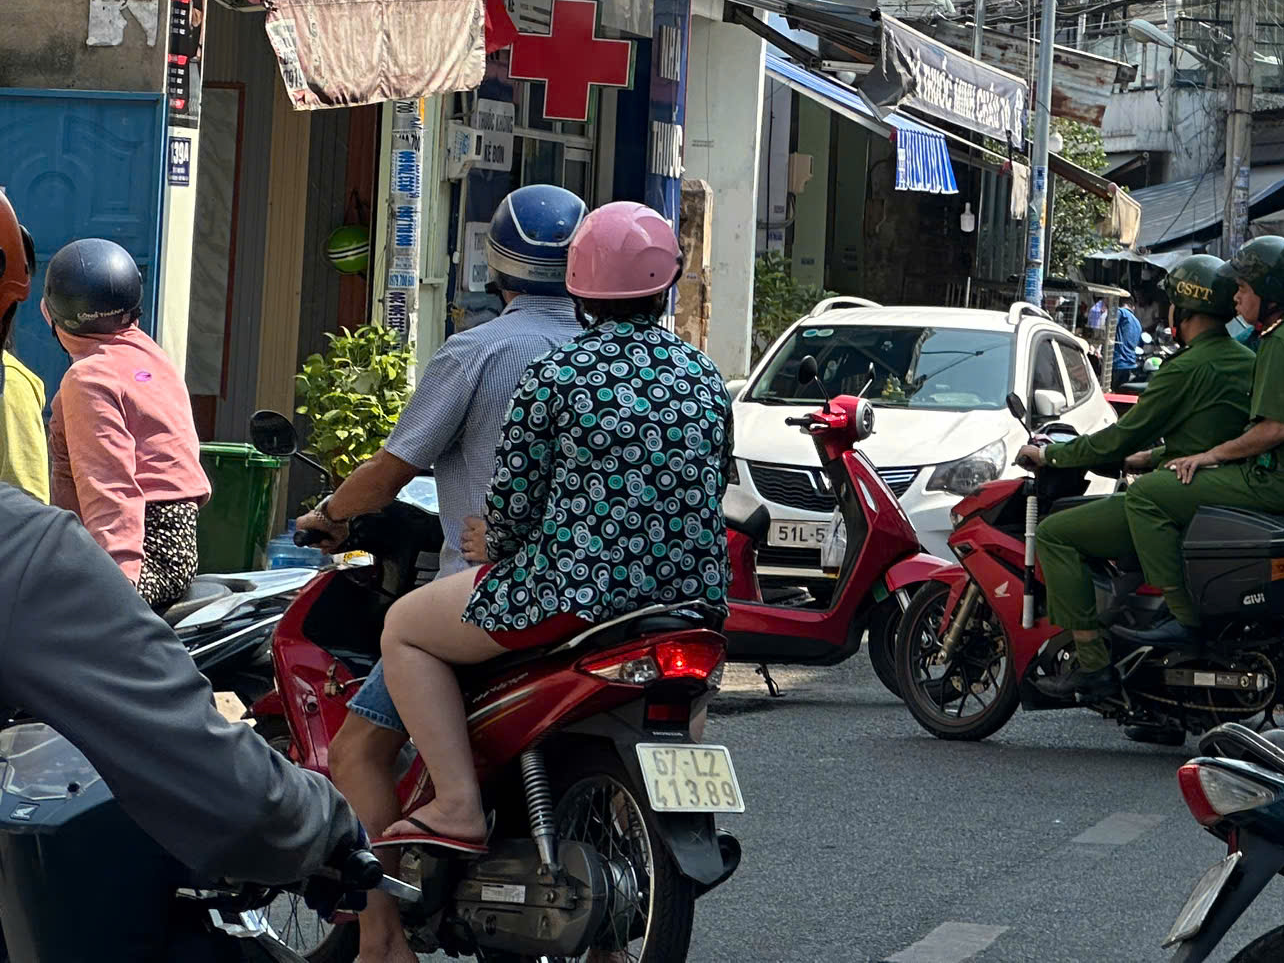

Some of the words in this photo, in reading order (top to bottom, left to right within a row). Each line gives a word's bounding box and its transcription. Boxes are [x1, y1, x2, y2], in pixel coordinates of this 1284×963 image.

[1176, 281, 1213, 301] CSTT
[1243, 593, 1266, 605] GIVI
[653, 749, 721, 777] 67-L2
[654, 778, 737, 807] 413.89
